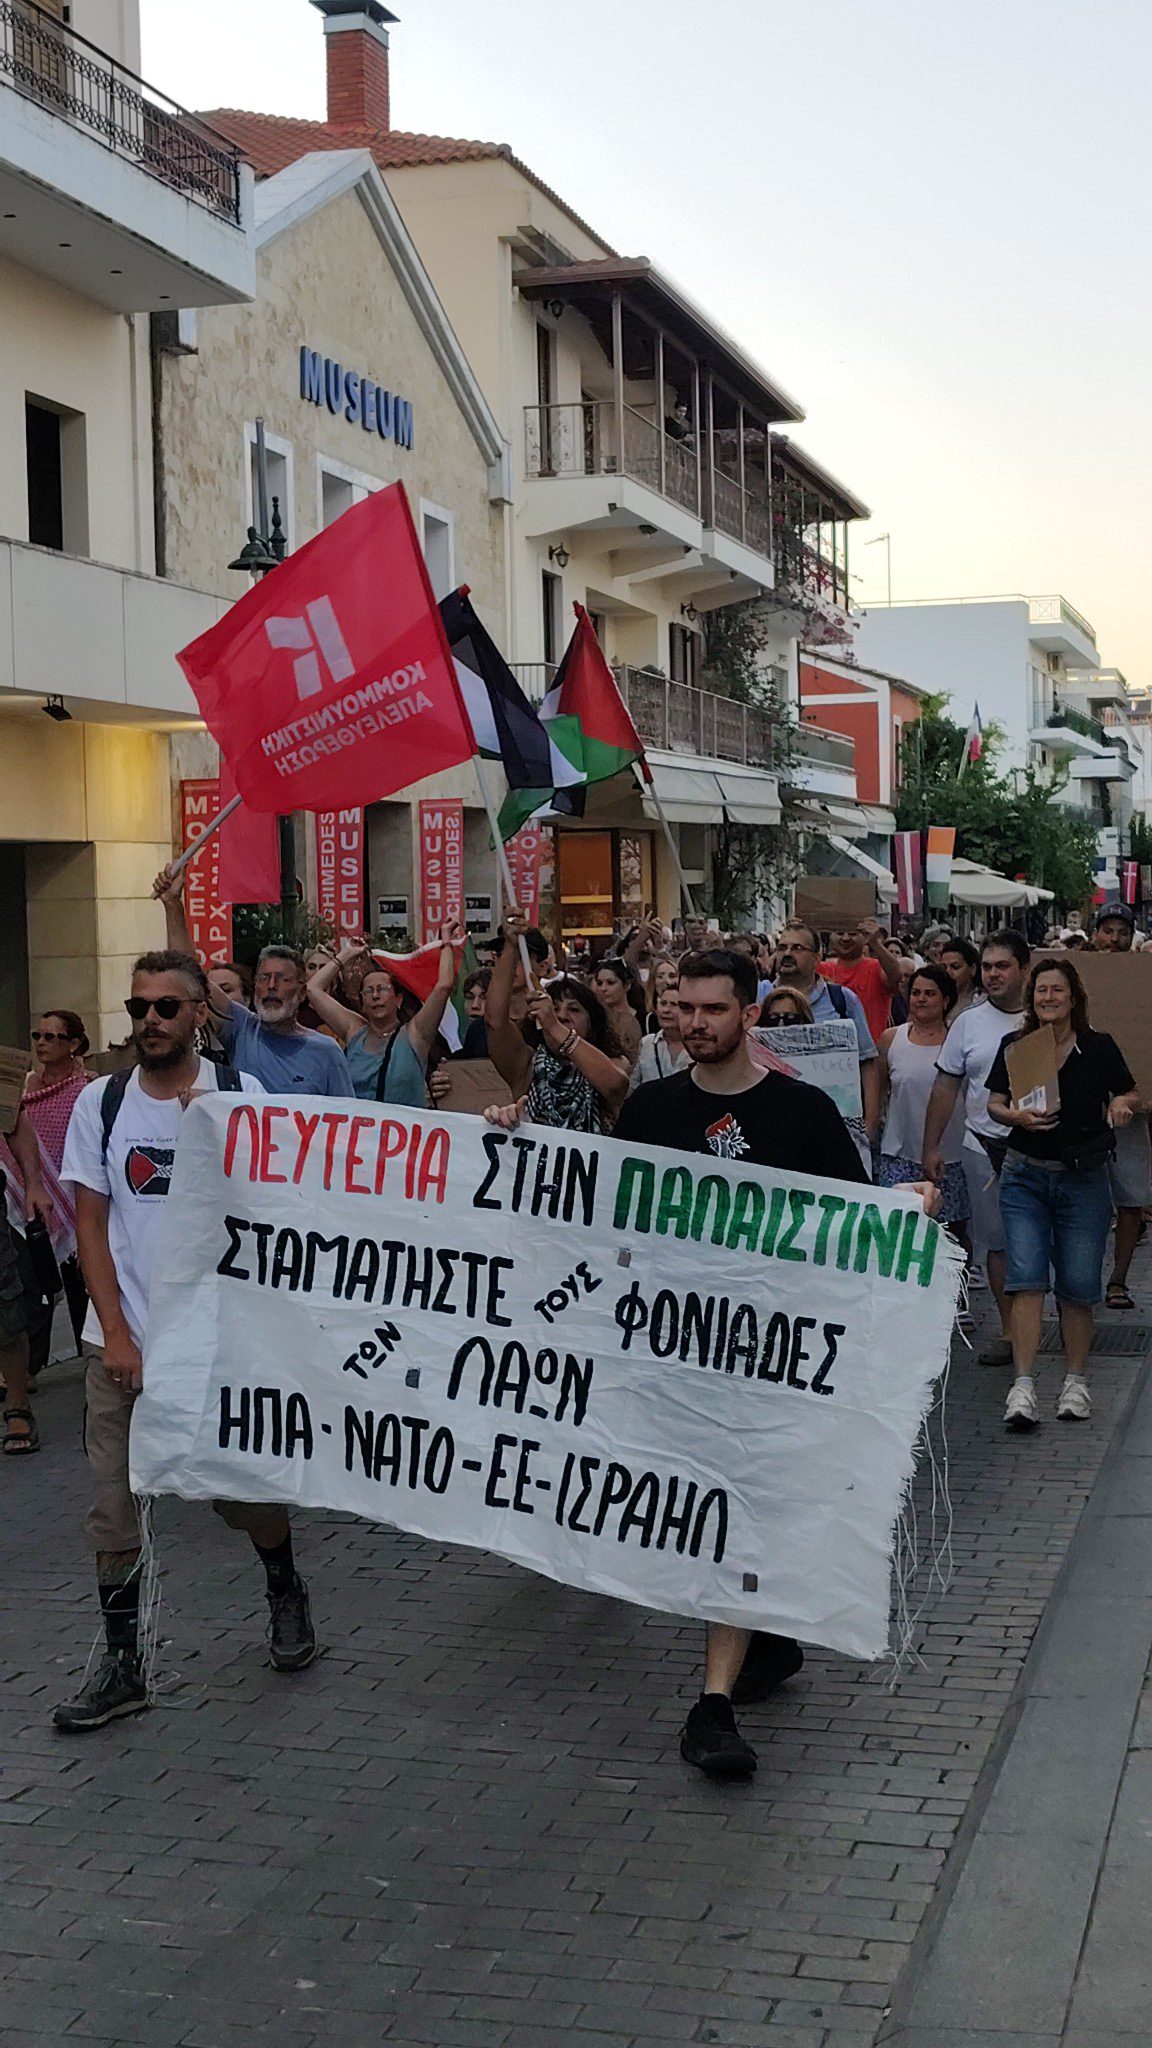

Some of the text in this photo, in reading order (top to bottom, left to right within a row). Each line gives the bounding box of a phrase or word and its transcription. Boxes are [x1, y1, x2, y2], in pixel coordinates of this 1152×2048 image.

[300, 345, 414, 451] MUSEUM
[224, 1104, 940, 1288] ΛΕΥΤΕΡΙΑ ΣΤΗΝ ΠΑΛΑΙΣΤΙΝΗ
[217, 1214, 846, 1396] ΣΤΑΜΑΤΗΣΤΕ ΤΟΥΣ ΦΟΝΙΑΔΕΣ
